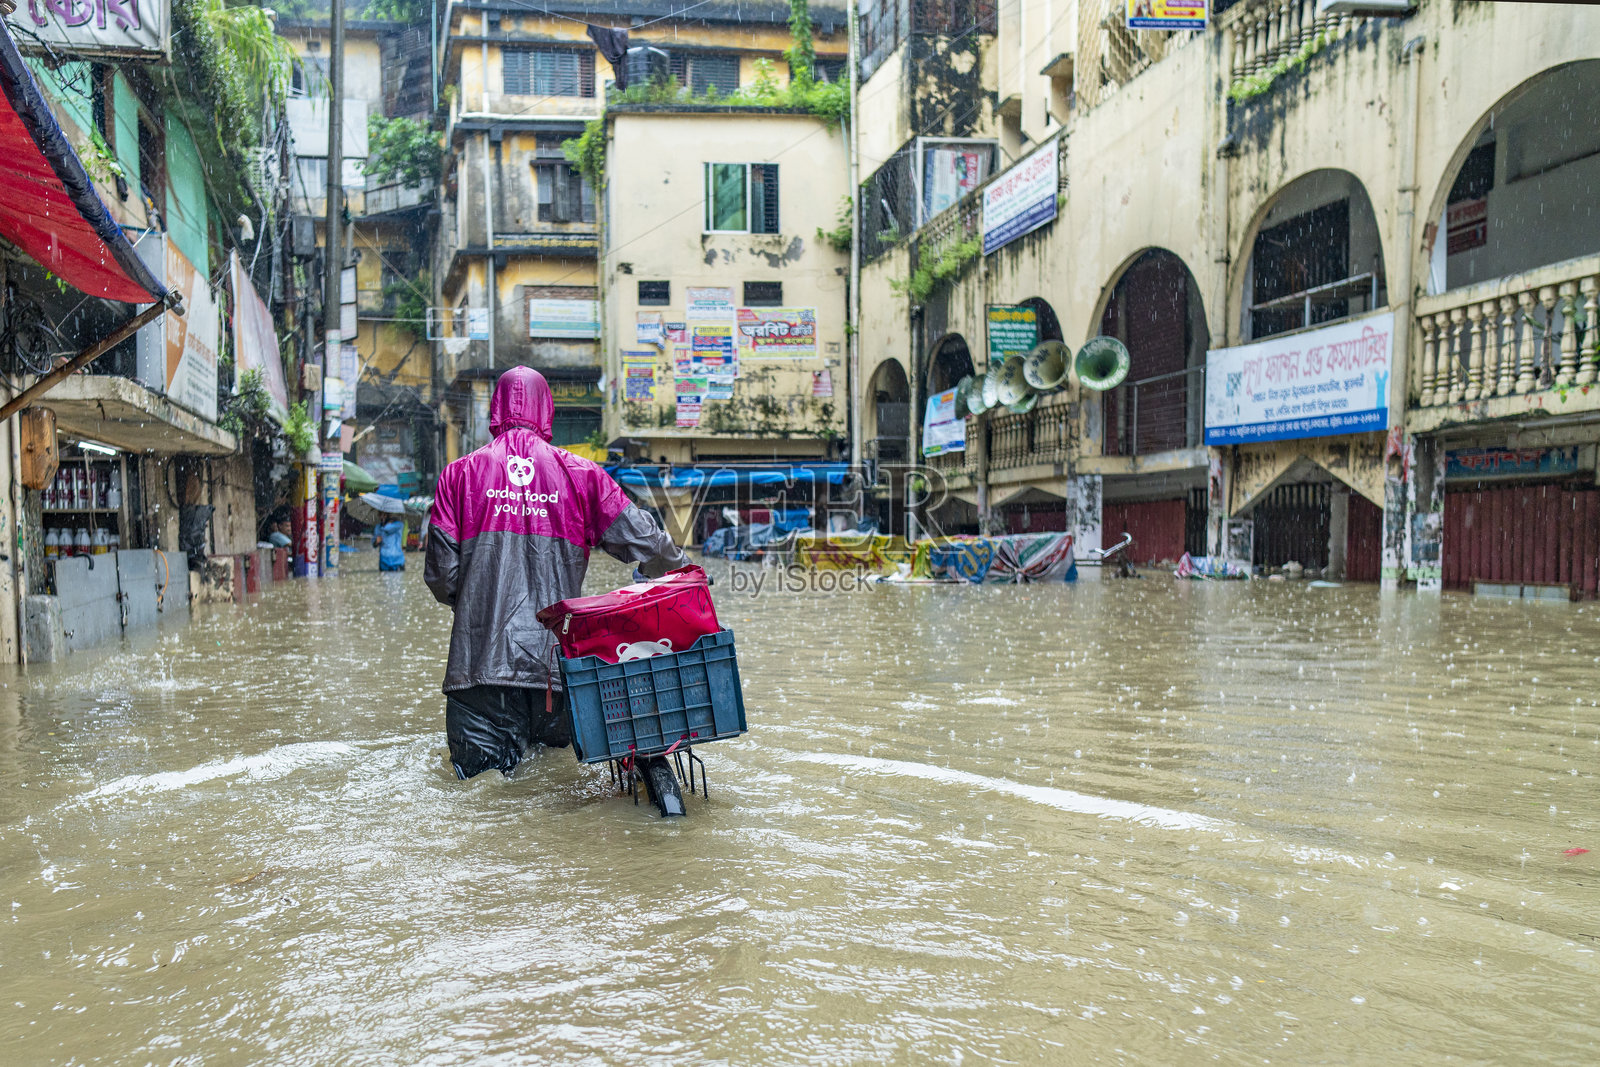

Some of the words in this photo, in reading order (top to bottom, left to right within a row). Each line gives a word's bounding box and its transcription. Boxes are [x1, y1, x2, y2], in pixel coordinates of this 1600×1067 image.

[694, 336, 723, 345] SSC
[486, 486, 523, 502] order
[524, 490, 559, 503] food
[493, 503, 518, 517] you
[522, 504, 548, 517] love
